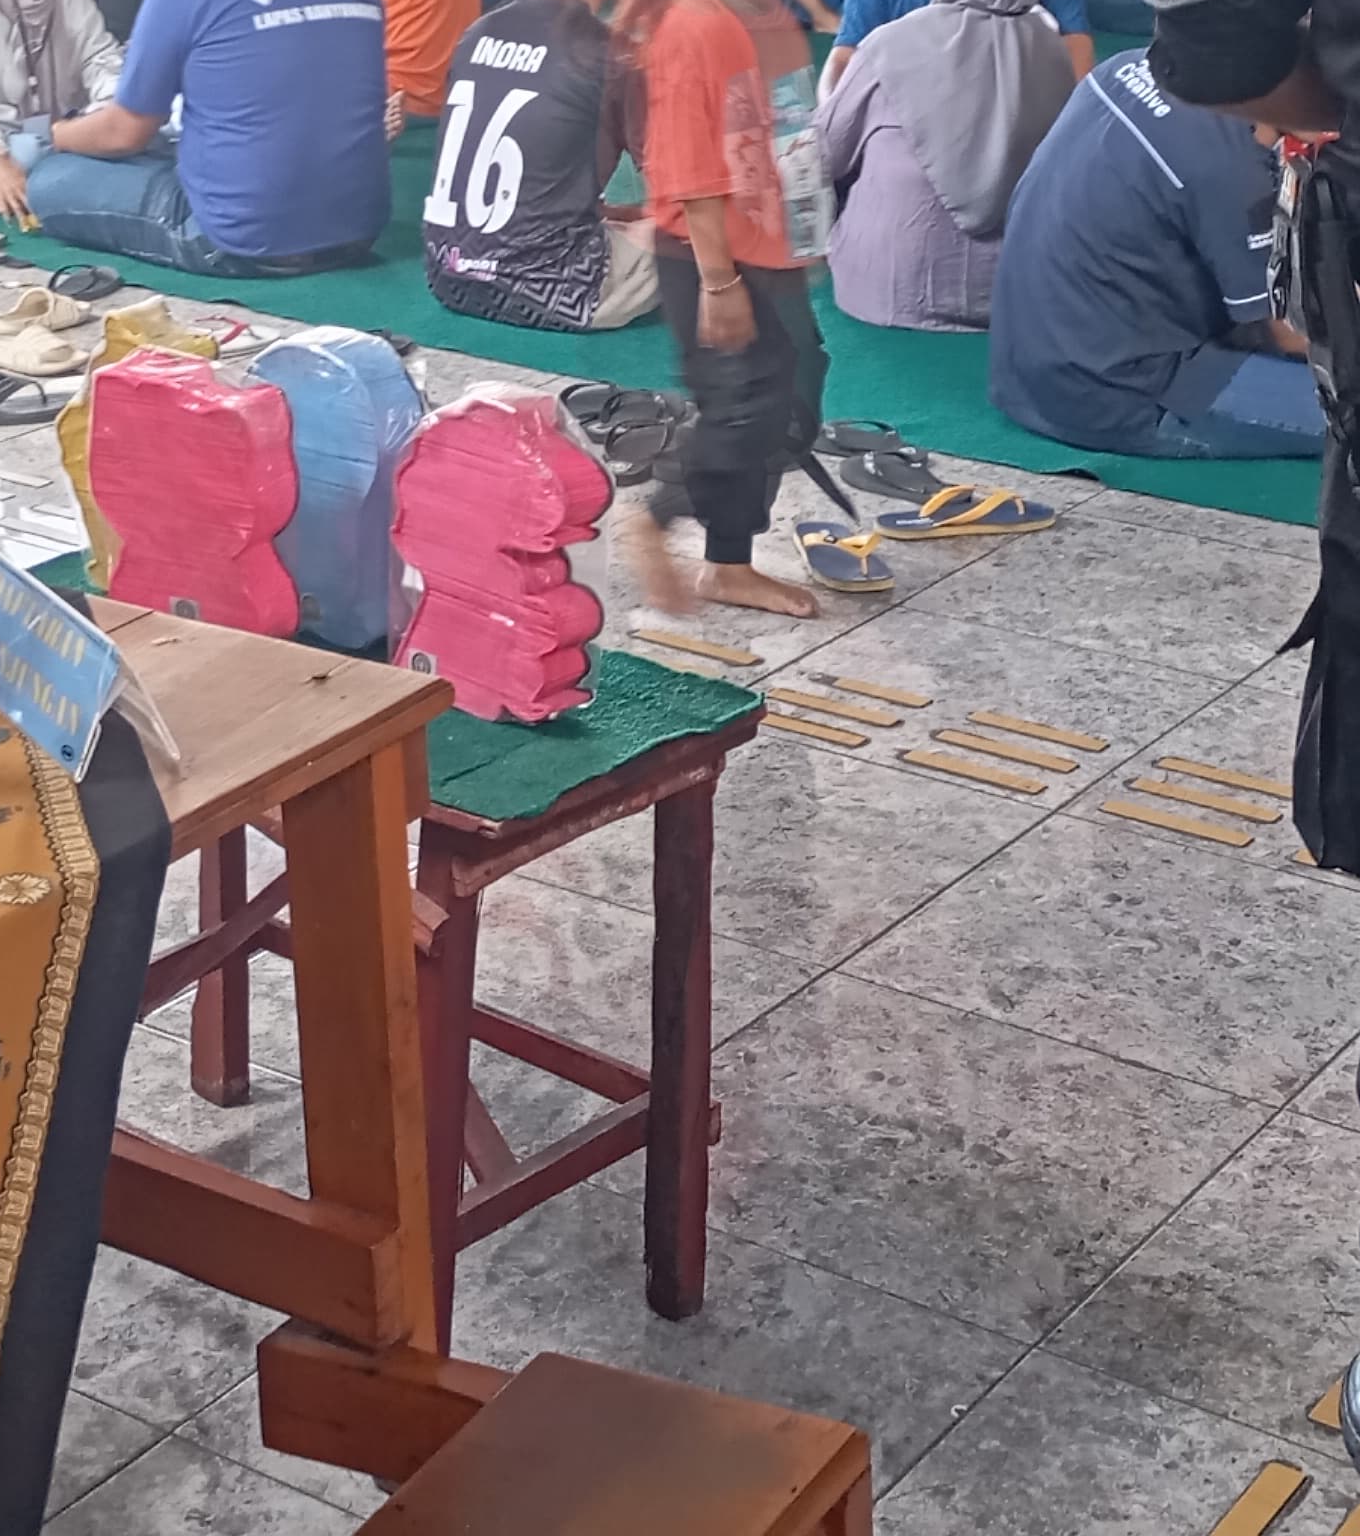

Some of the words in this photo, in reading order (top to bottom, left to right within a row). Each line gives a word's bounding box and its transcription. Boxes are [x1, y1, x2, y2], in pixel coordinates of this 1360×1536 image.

[469, 35, 548, 74] INDRA
[1115, 61, 1172, 119] Creative
[422, 78, 540, 235] 16
